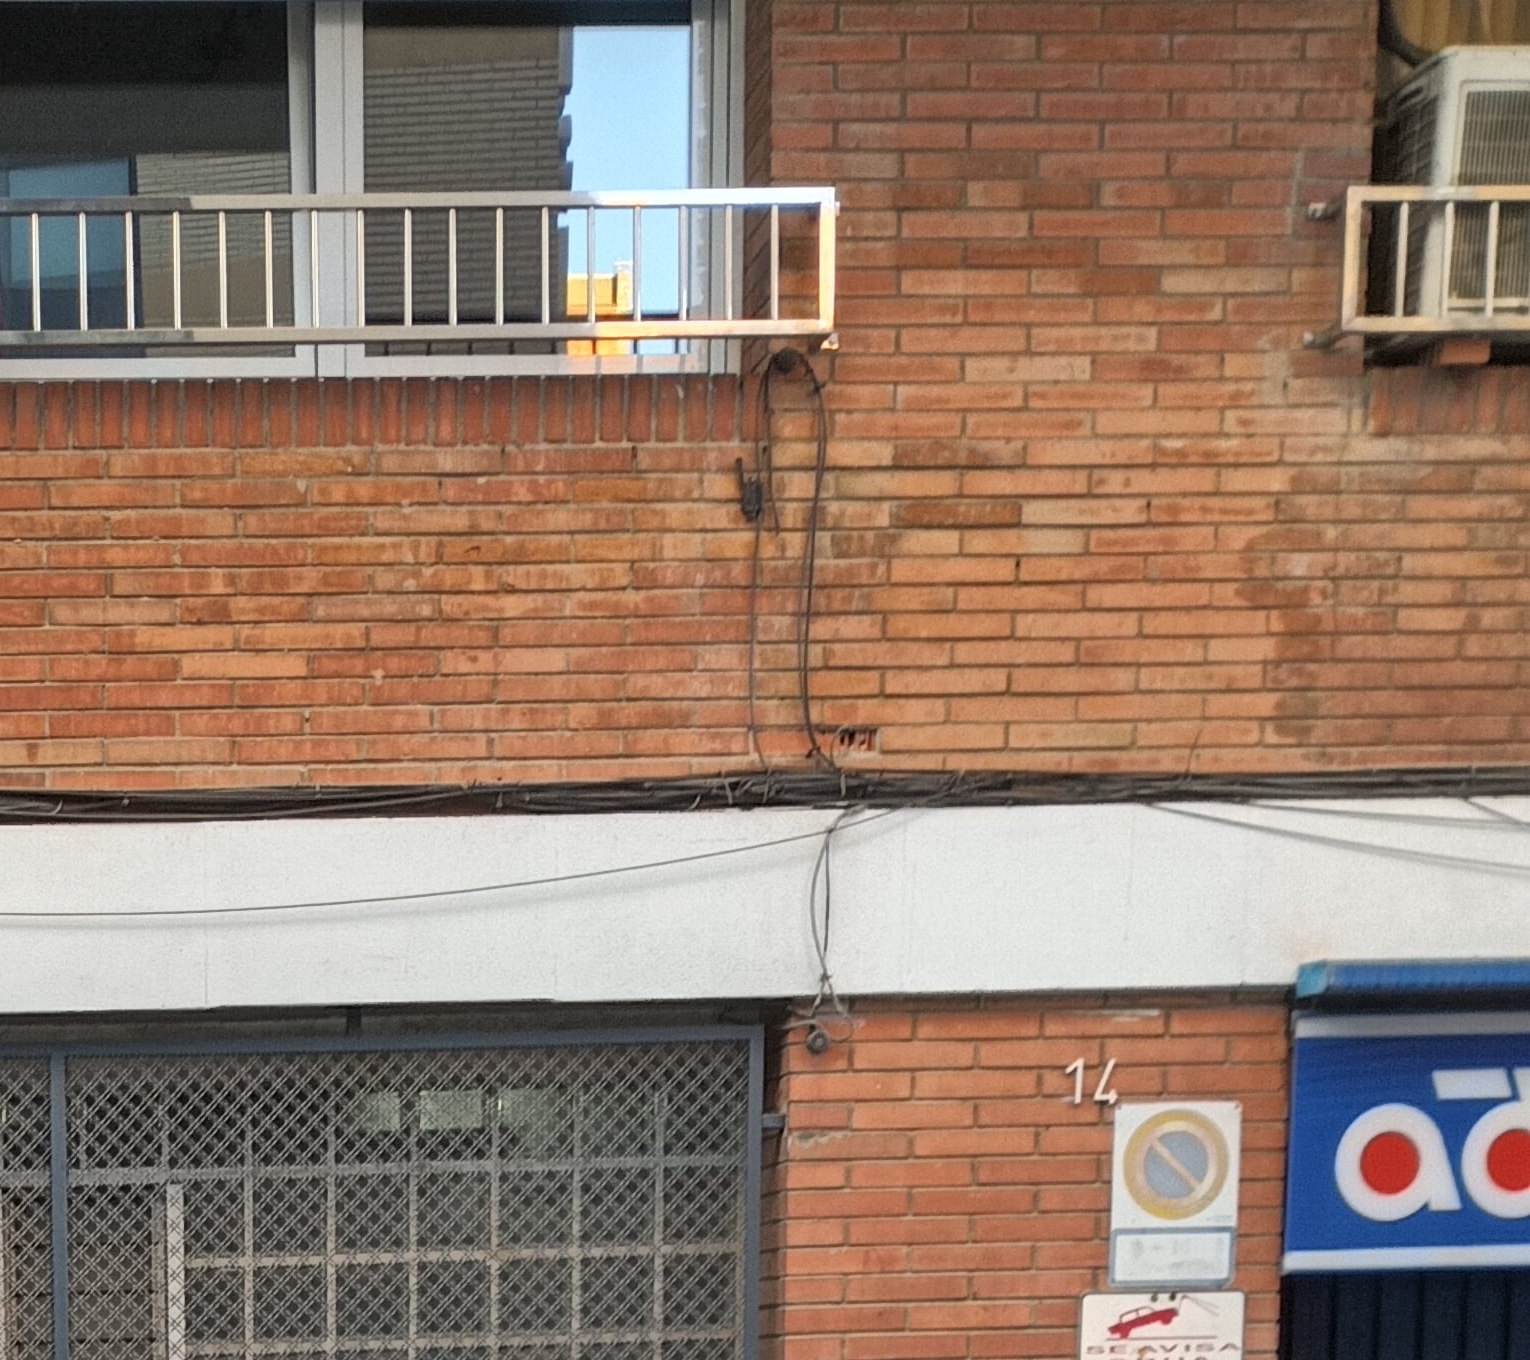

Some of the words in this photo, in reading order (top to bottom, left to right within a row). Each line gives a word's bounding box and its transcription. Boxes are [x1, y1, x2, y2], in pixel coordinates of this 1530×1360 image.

[1064, 1057, 1119, 1106] 14
[1085, 1343, 1128, 1357] SE
[1131, 1341, 1240, 1356] AVISA
